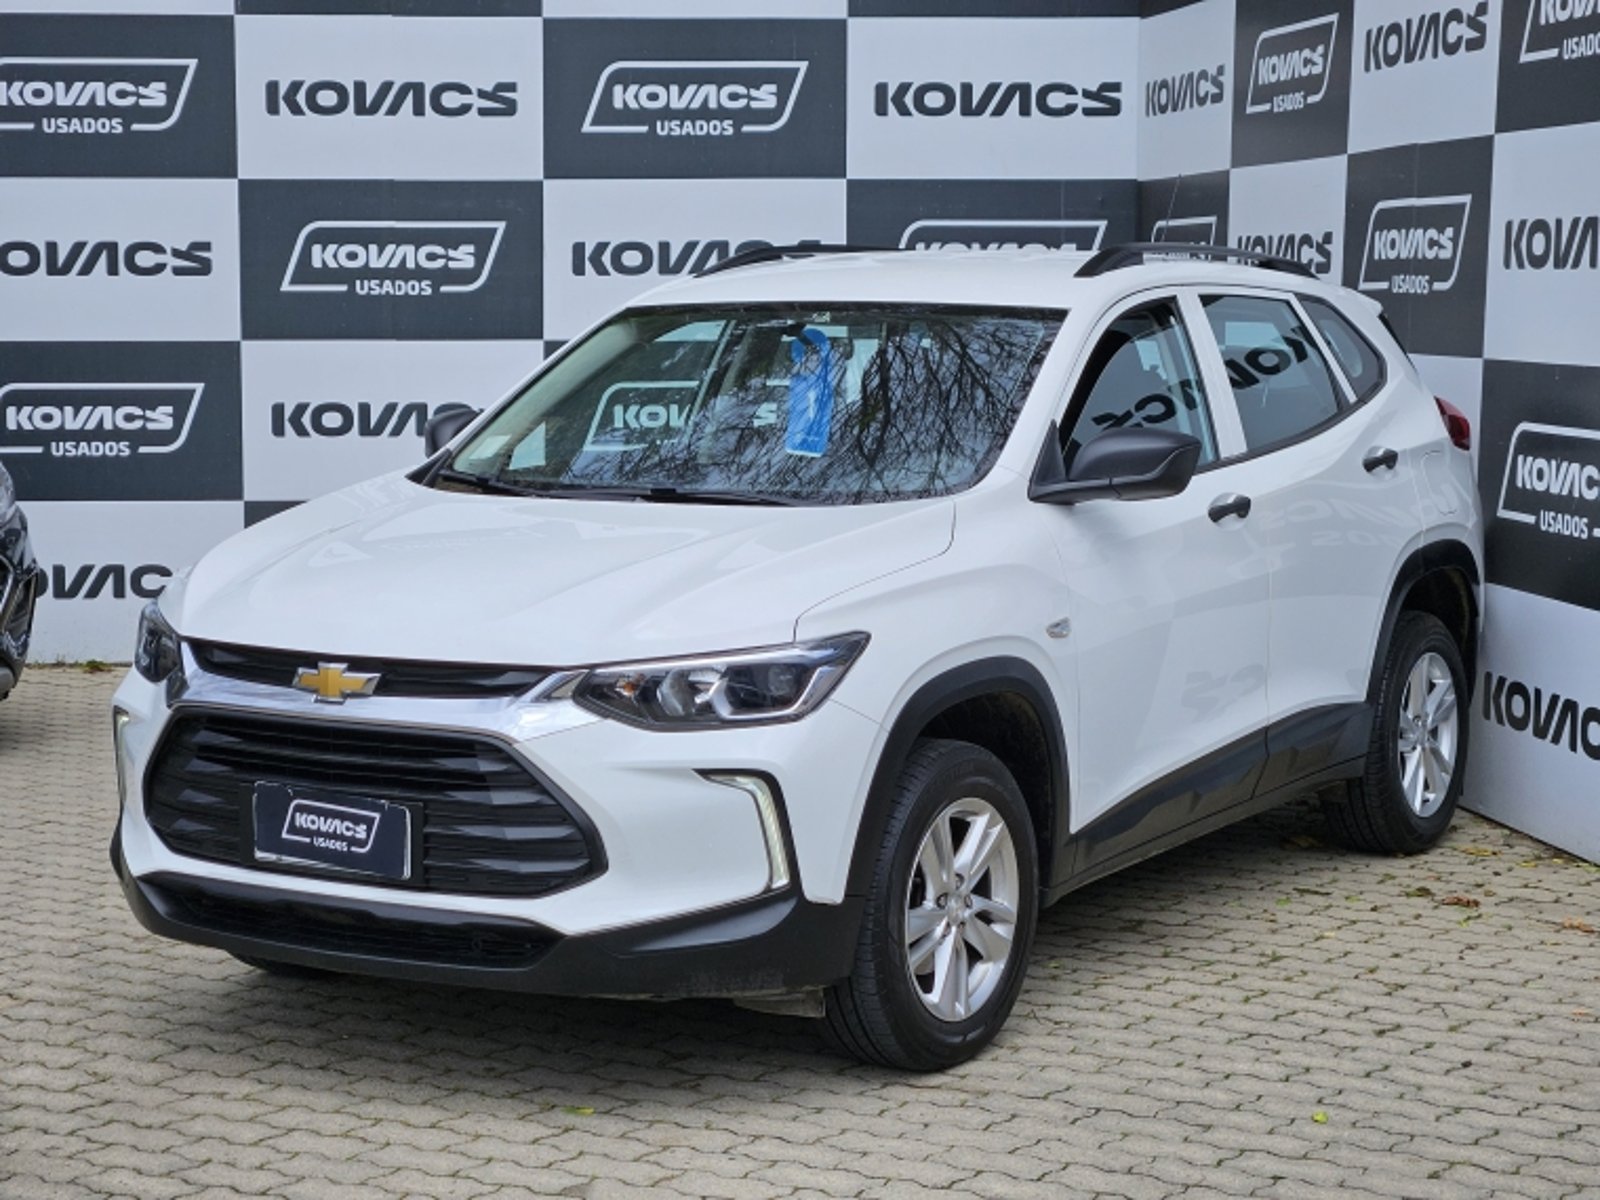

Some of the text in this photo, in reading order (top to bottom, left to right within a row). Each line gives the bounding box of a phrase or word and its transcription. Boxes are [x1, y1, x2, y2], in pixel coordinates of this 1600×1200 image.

[1364, 1, 1488, 73] KOVACS
[1258, 44, 1325, 84] KOVACS
[0, 81, 167, 107] KOVACS
[265, 80, 518, 117] KOVACS
[612, 83, 778, 110] KOVACS
[874, 81, 1122, 117] KOVACS
[1145, 64, 1225, 117] KOVACS
[1273, 91, 1305, 113] USADOS
[42, 118, 123, 134] USADOS
[656, 119, 733, 136] USADOS
[312, 243, 475, 269] KOVACS
[1374, 227, 1454, 261] KOVACS
[1503, 216, 1599, 270] KOVA
[0, 241, 212, 276] OVACS
[355, 280, 432, 296] USADOS
[1391, 274, 1430, 294] USADOS
[6, 405, 173, 431] KOVACS
[271, 402, 472, 437] KOVA
[51, 441, 130, 457] USADOS
[1516, 454, 1600, 500] KOVAC
[1540, 509, 1588, 539] USADOS
[1482, 671, 1600, 761] KOVAC
[295, 812, 367, 839] KOVACS
[313, 836, 349, 851] USADOS
